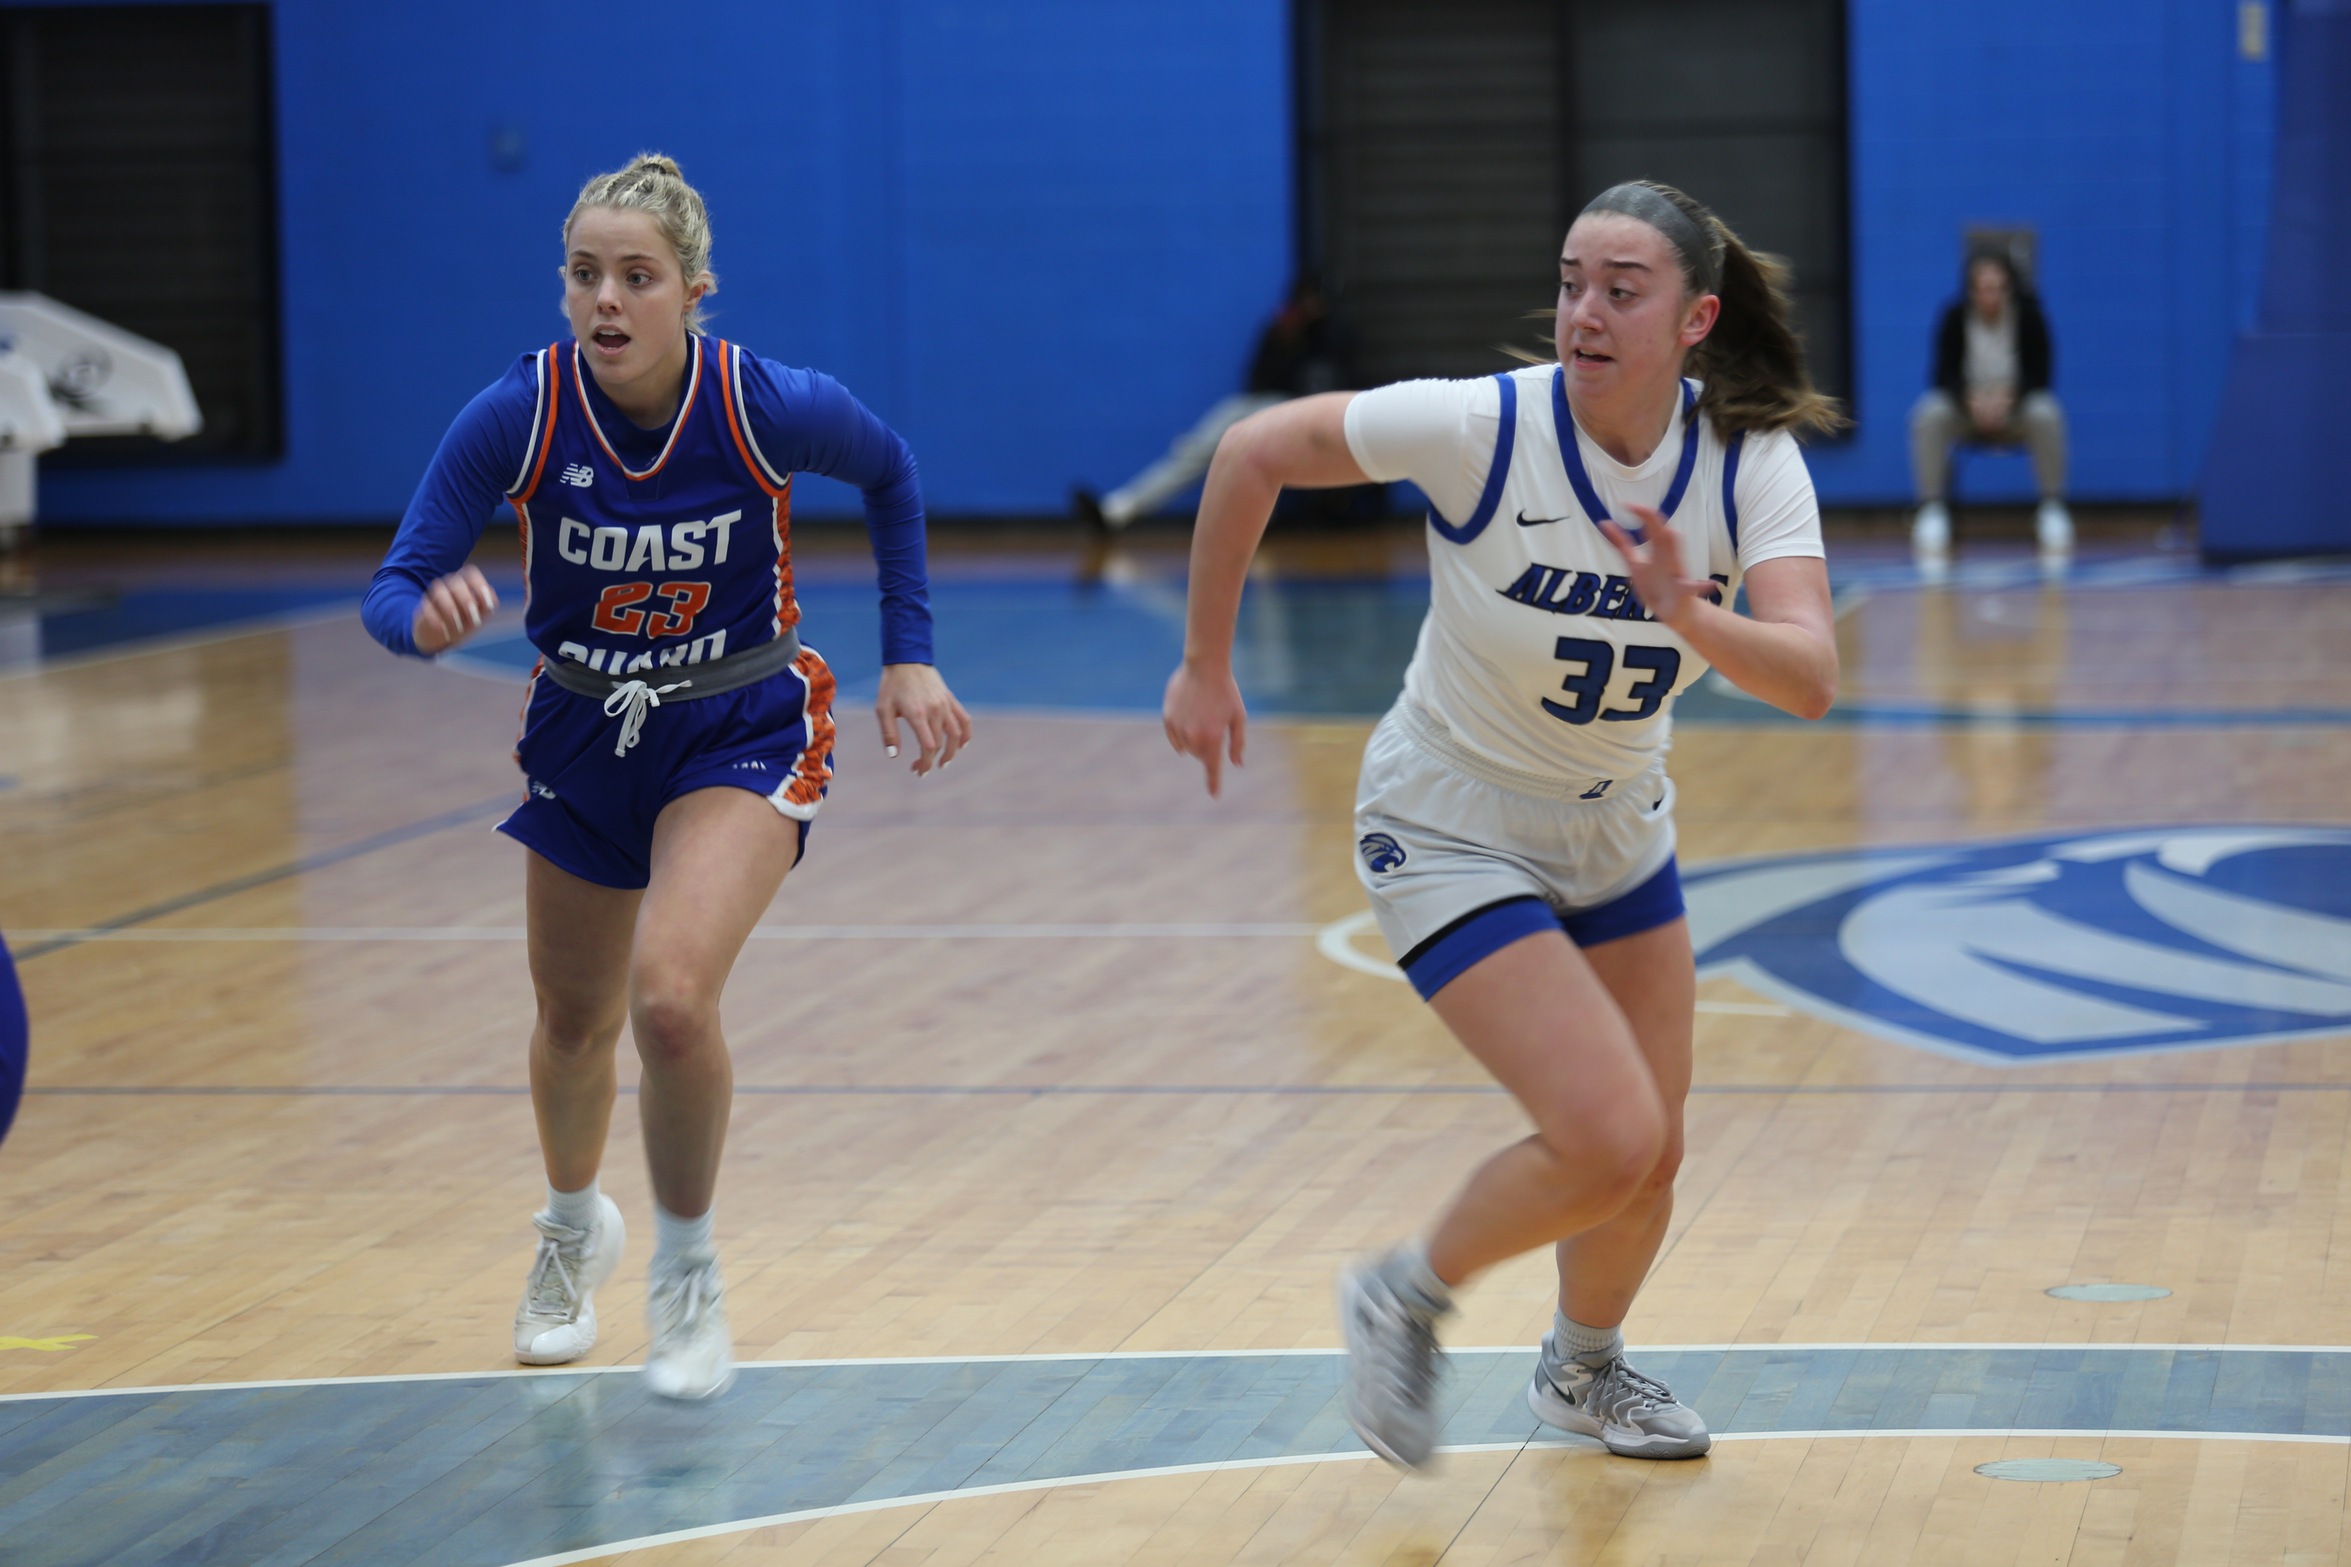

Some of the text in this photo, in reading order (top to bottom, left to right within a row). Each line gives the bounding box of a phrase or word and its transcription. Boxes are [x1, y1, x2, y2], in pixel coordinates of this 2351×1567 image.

[558, 508, 742, 572] COAST
[590, 581, 712, 640] 23
[1495, 562, 1730, 623] ALBERS
[1541, 636, 1681, 725] 33
